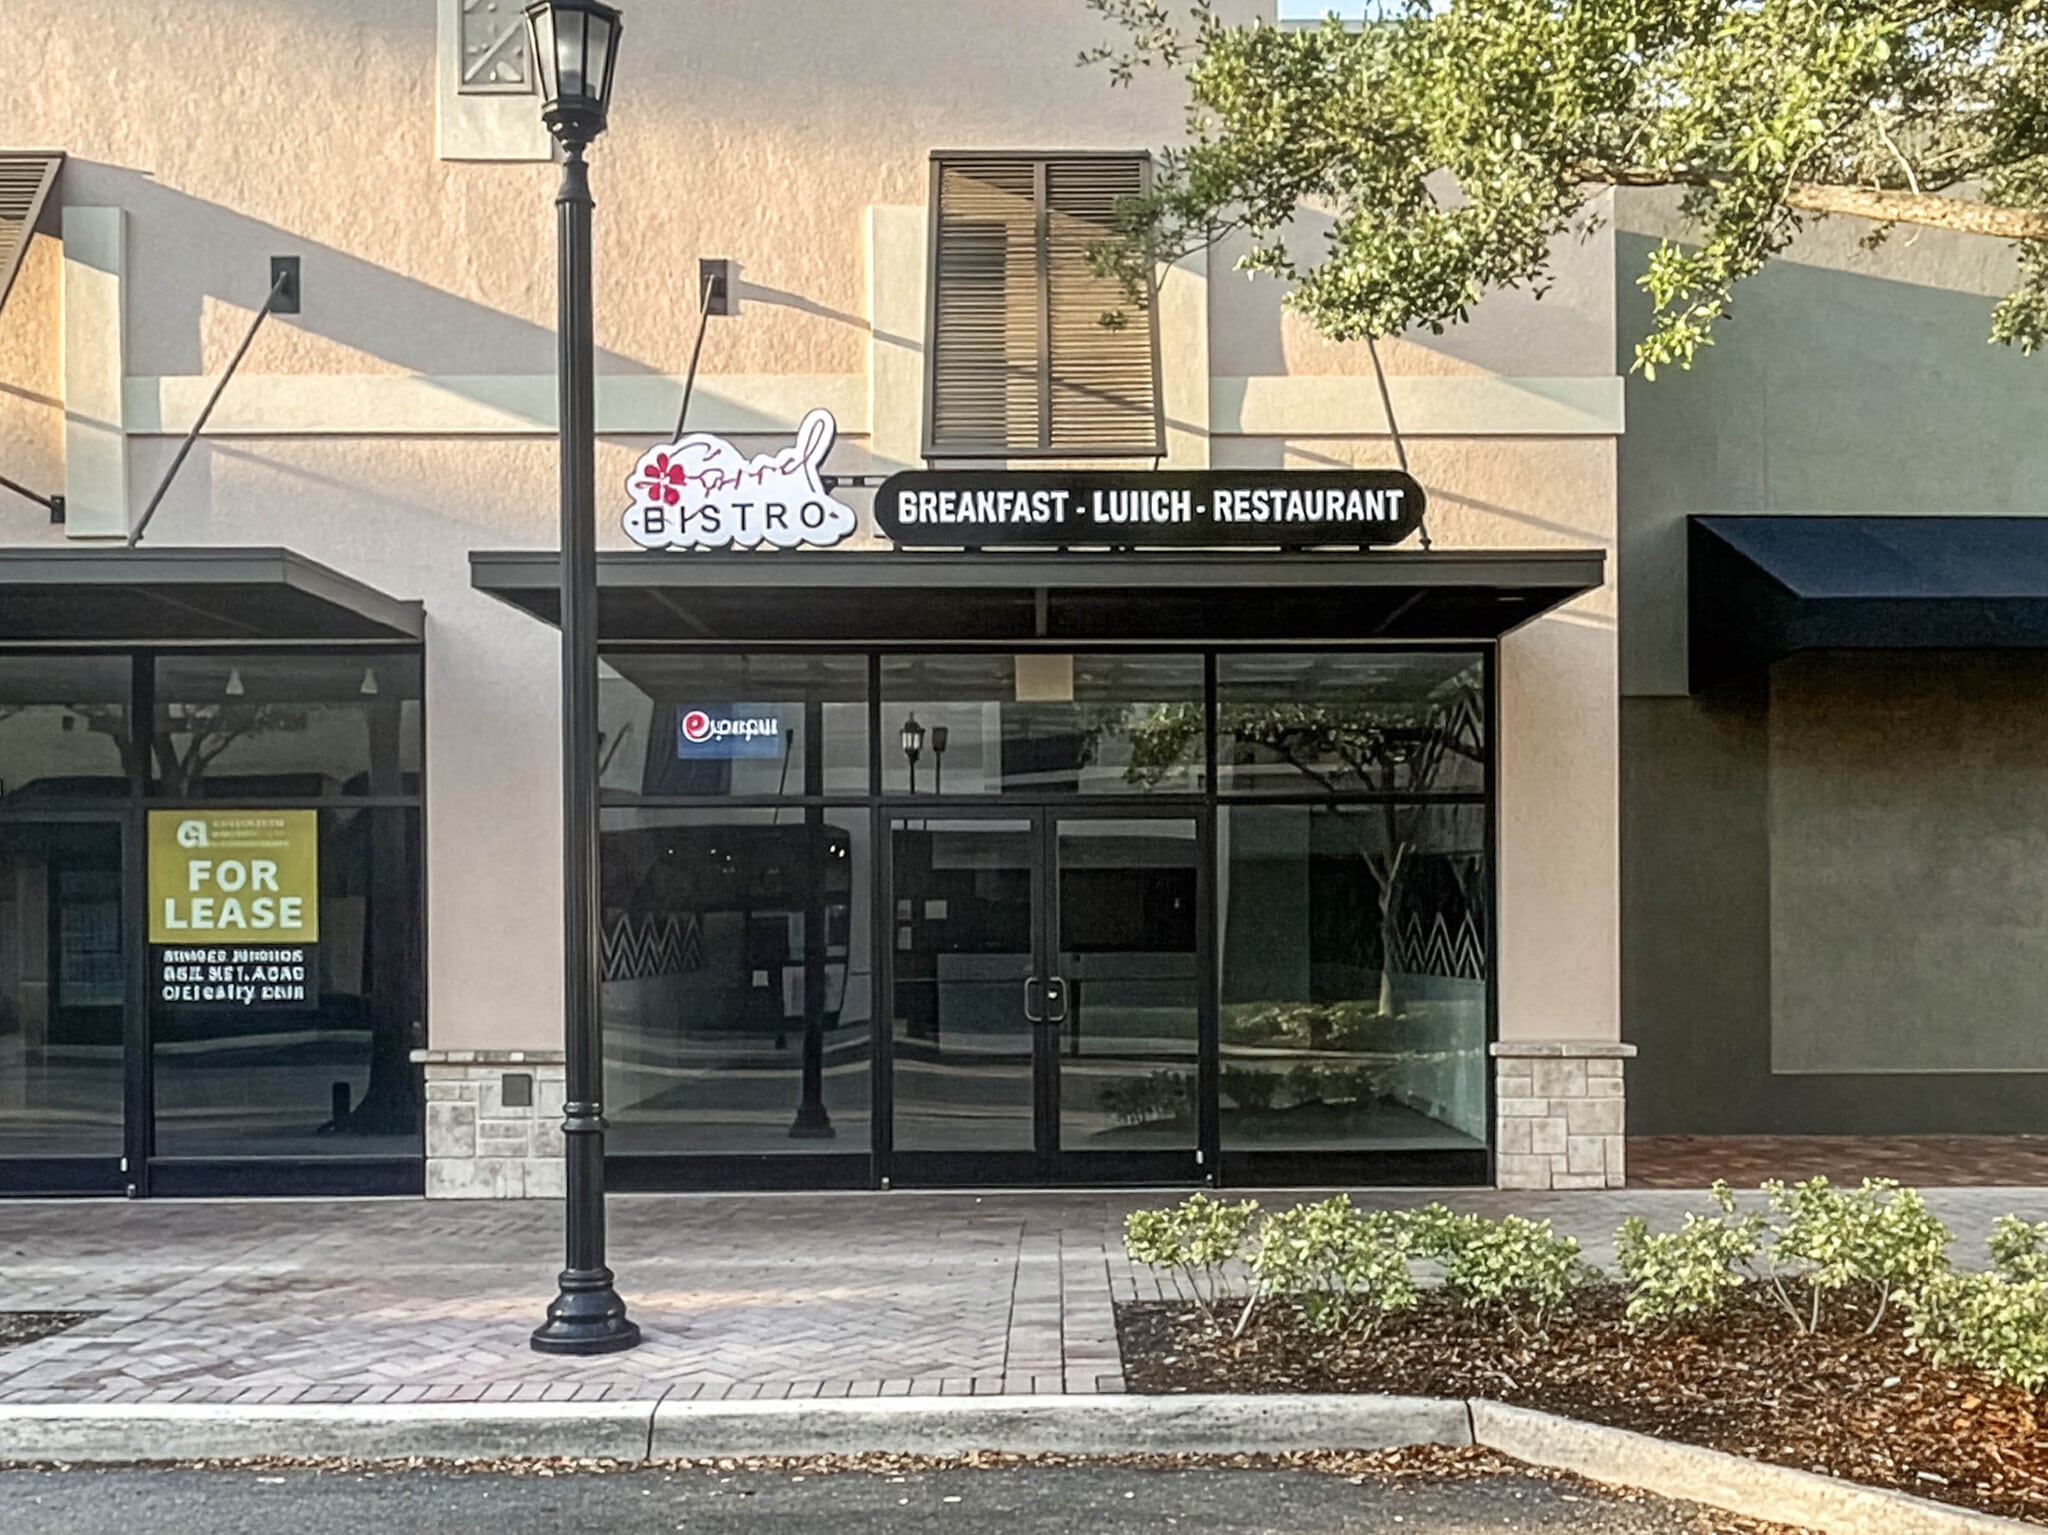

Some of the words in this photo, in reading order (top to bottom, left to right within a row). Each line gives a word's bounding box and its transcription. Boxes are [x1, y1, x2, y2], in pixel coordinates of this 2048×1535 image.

[644, 500, 825, 535] BISTRO
[1213, 489, 1405, 522] RESTAURANT
[188, 859, 280, 892] FOR
[165, 896, 303, 929] LEASE
